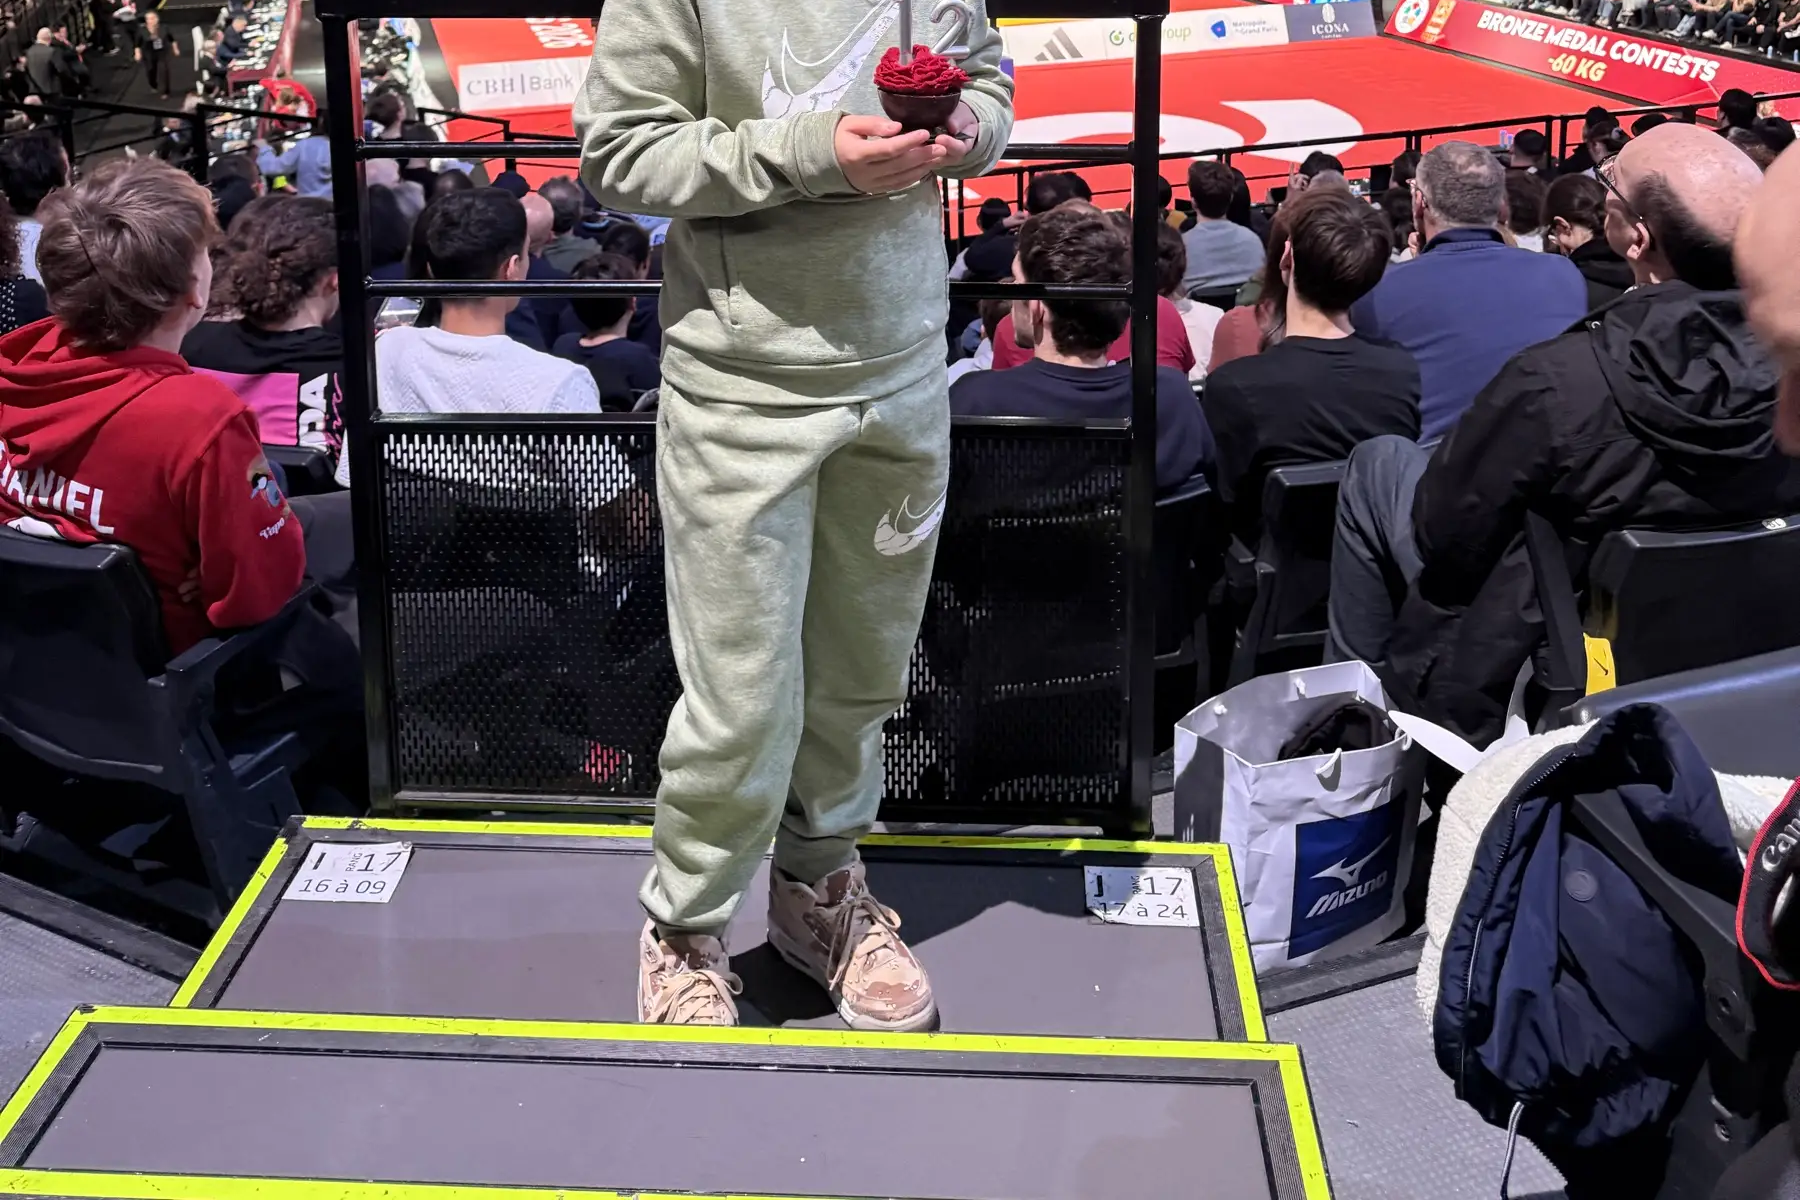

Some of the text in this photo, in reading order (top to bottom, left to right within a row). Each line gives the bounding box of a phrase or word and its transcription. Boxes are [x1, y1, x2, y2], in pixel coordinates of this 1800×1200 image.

[1312, 23, 1350, 35] ICONA
[1477, 10, 1721, 82] BRONZE MEDAL CONTESTS
[1574, 61, 1608, 82] KG
[466, 74, 574, 96] CBH Bank
[356, 852, 403, 872] 17
[298, 879, 386, 895] 16 à 09
[1143, 876, 1183, 896] 17
[1099, 902, 1188, 919] 17 à 24
